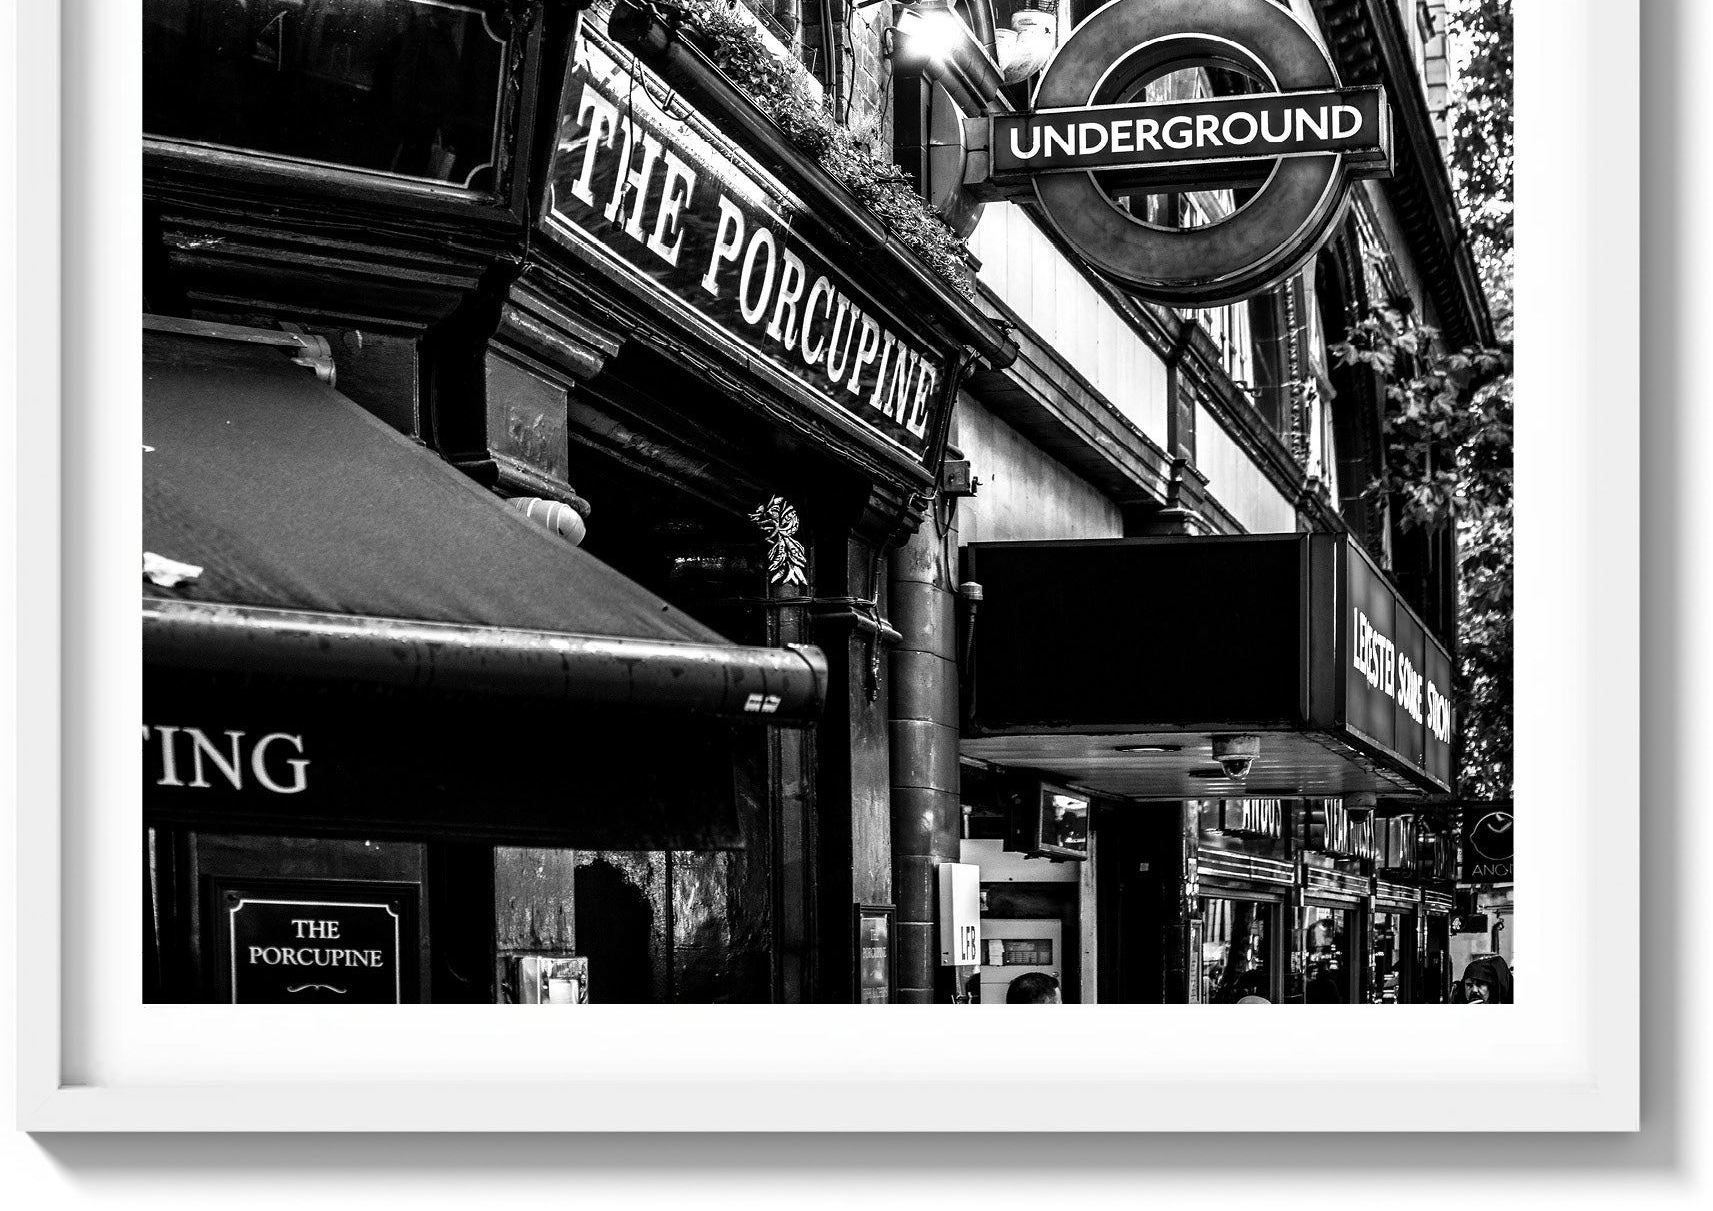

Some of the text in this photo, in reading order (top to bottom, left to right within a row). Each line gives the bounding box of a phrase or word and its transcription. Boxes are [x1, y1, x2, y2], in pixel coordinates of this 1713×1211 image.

[1009, 105, 1363, 160] UNDERGROUND
[570, 82, 939, 440] THE PORCUPINE
[142, 724, 311, 794] ING
[249, 945, 384, 968] PORCUPINE
[291, 919, 340, 939] THE
